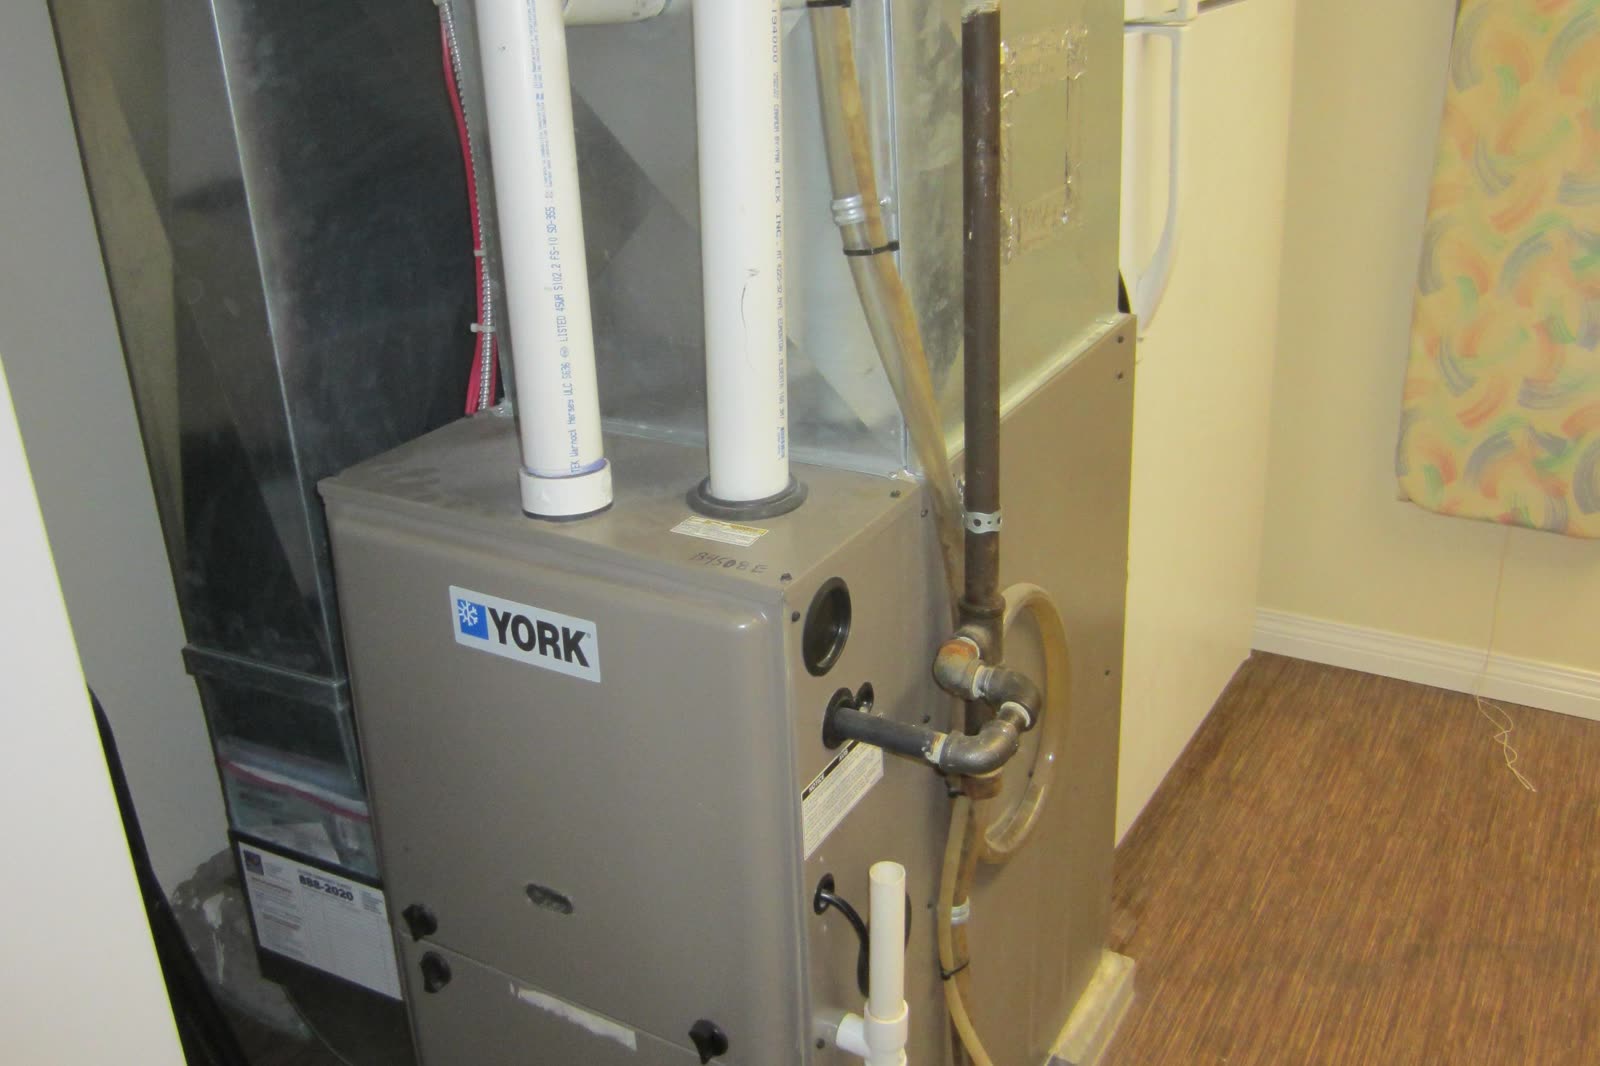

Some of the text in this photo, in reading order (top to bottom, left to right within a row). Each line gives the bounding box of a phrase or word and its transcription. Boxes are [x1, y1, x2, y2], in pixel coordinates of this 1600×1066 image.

[548, 237, 560, 261] FS-10
[551, 264, 563, 290] S102.2
[556, 316, 568, 341] LISTED
[563, 383, 574, 396] ULC
[567, 399, 576, 424] Hersey
[488, 607, 590, 668] YORK
[299, 875, 354, 901] 888-2020
